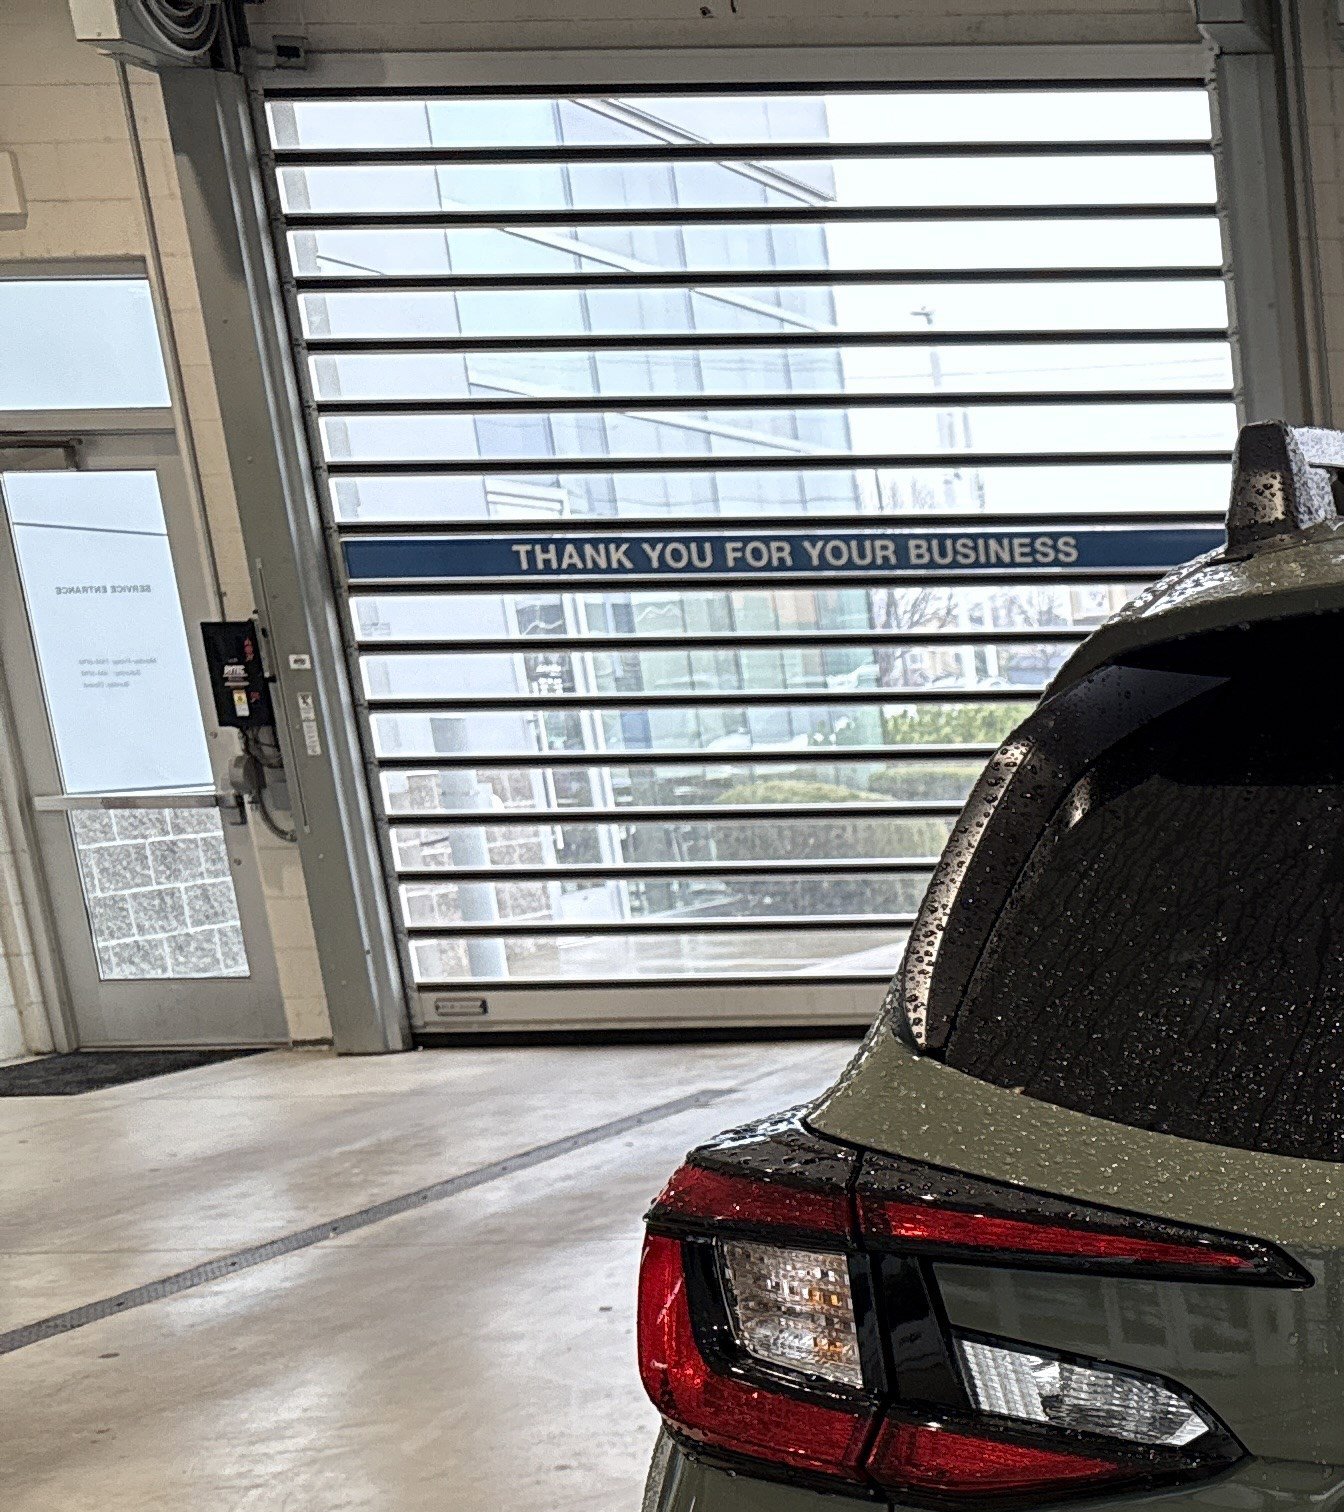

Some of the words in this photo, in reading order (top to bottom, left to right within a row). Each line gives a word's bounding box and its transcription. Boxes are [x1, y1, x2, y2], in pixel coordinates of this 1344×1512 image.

[512, 542, 635, 571] THANK
[641, 541, 714, 570] YOU
[726, 540, 793, 568] FOR
[803, 538, 897, 567] YOUR
[908, 537, 1079, 566] BUSINESS
